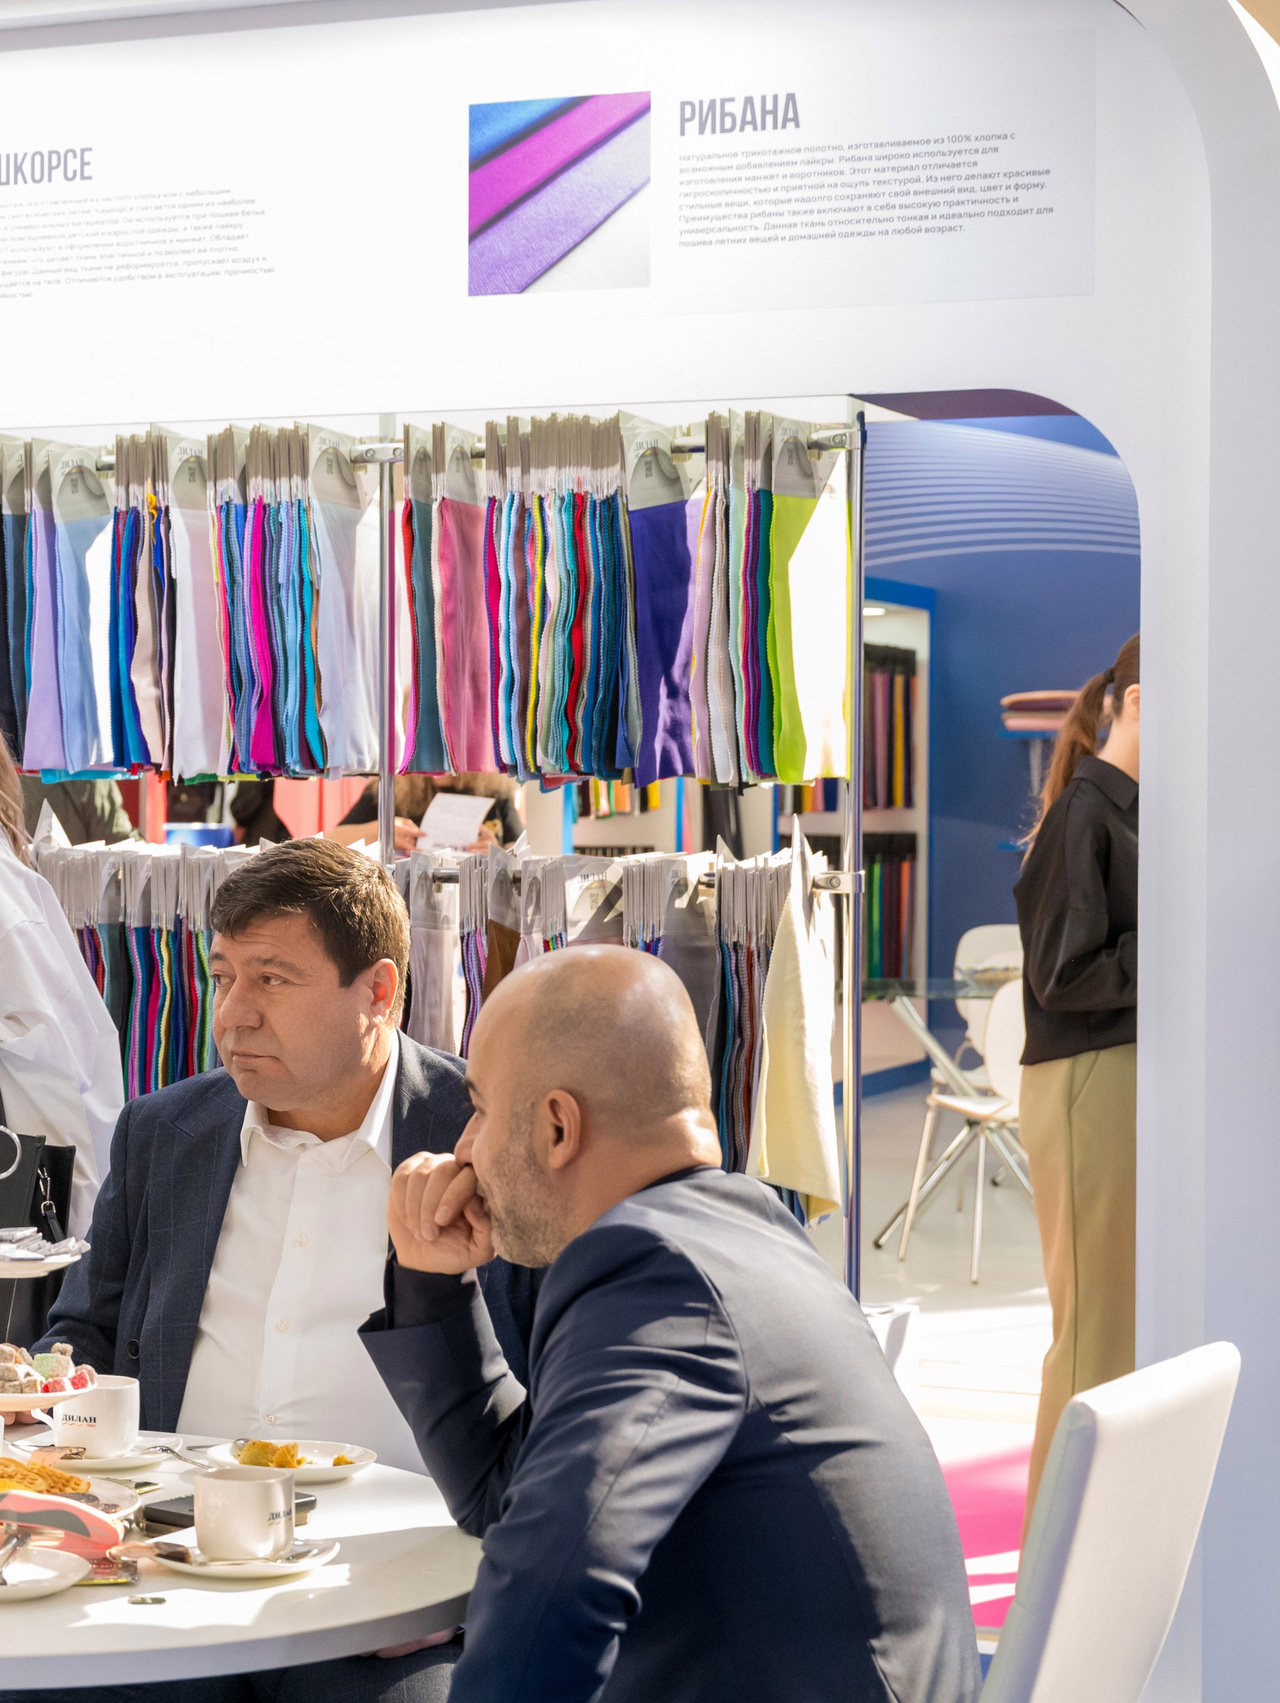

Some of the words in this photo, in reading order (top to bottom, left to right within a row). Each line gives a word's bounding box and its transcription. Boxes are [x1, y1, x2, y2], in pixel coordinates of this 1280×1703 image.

[680, 92, 801, 136] РИБАНА
[679, 152, 739, 162] Натуральное
[741, 147, 802, 158] трикотажное
[847, 138, 931, 150] изготавливаемое
[947, 134, 972, 143] 100%
[974, 133, 1008, 141] хлопка
[1009, 132, 1016, 140] с
[679, 165, 733, 174] возможным
[735, 160, 798, 170] добавлением
[838, 155, 873, 163] Рибана
[875, 152, 911, 162] широко
[912, 148, 979, 158] используется
[981, 146, 999, 154] для
[678, 187, 771, 199] гигроскопичностью
[780, 183, 825, 193] приятной
[840, 180, 870, 189] ощупь
[926, 175, 938, 183] Из
[964, 172, 1001, 181] делают
[1003, 168, 1051, 179] красивые
[679, 176, 742, 186] изготовления
[744, 173, 779, 181] манжет
[849, 167, 871, 175] Этот
[873, 164, 920, 174] материал
[921, 160, 978, 170] отличается
[678, 202, 722, 211] стильные
[753, 198, 792, 206] которые
[794, 195, 833, 203] надолго
[834, 191, 886, 201] сохраняют
[888, 190, 911, 198] свой
[913, 188, 955, 196] внешний
[980, 184, 1003, 192] цвет
[678, 213, 748, 224] Преимущества
[750, 210, 785, 220] рибаны
[816, 205, 864, 214] включают
[874, 202, 896, 211] себя
[898, 201, 941, 210] высокую
[943, 197, 1011, 208] практичность
[763, 222, 798, 231] Данная
[827, 216, 894, 226] относительно
[897, 214, 929, 222] тонкая
[939, 211, 985, 220] идеально
[987, 208, 1034, 217] подходит
[1035, 207, 1054, 215] для
[788, 232, 836, 241] домашней
[837, 230, 876, 238] одежды
[891, 225, 922, 235] любой
[178, 446, 203, 457] ДИЛАН
[317, 435, 341, 449] ДИЛАН
[634, 438, 659, 452] ДИЛАН
[60, 456, 85, 470] ДИЛАН
[62, 1414, 97, 1424] ДИЛАН
